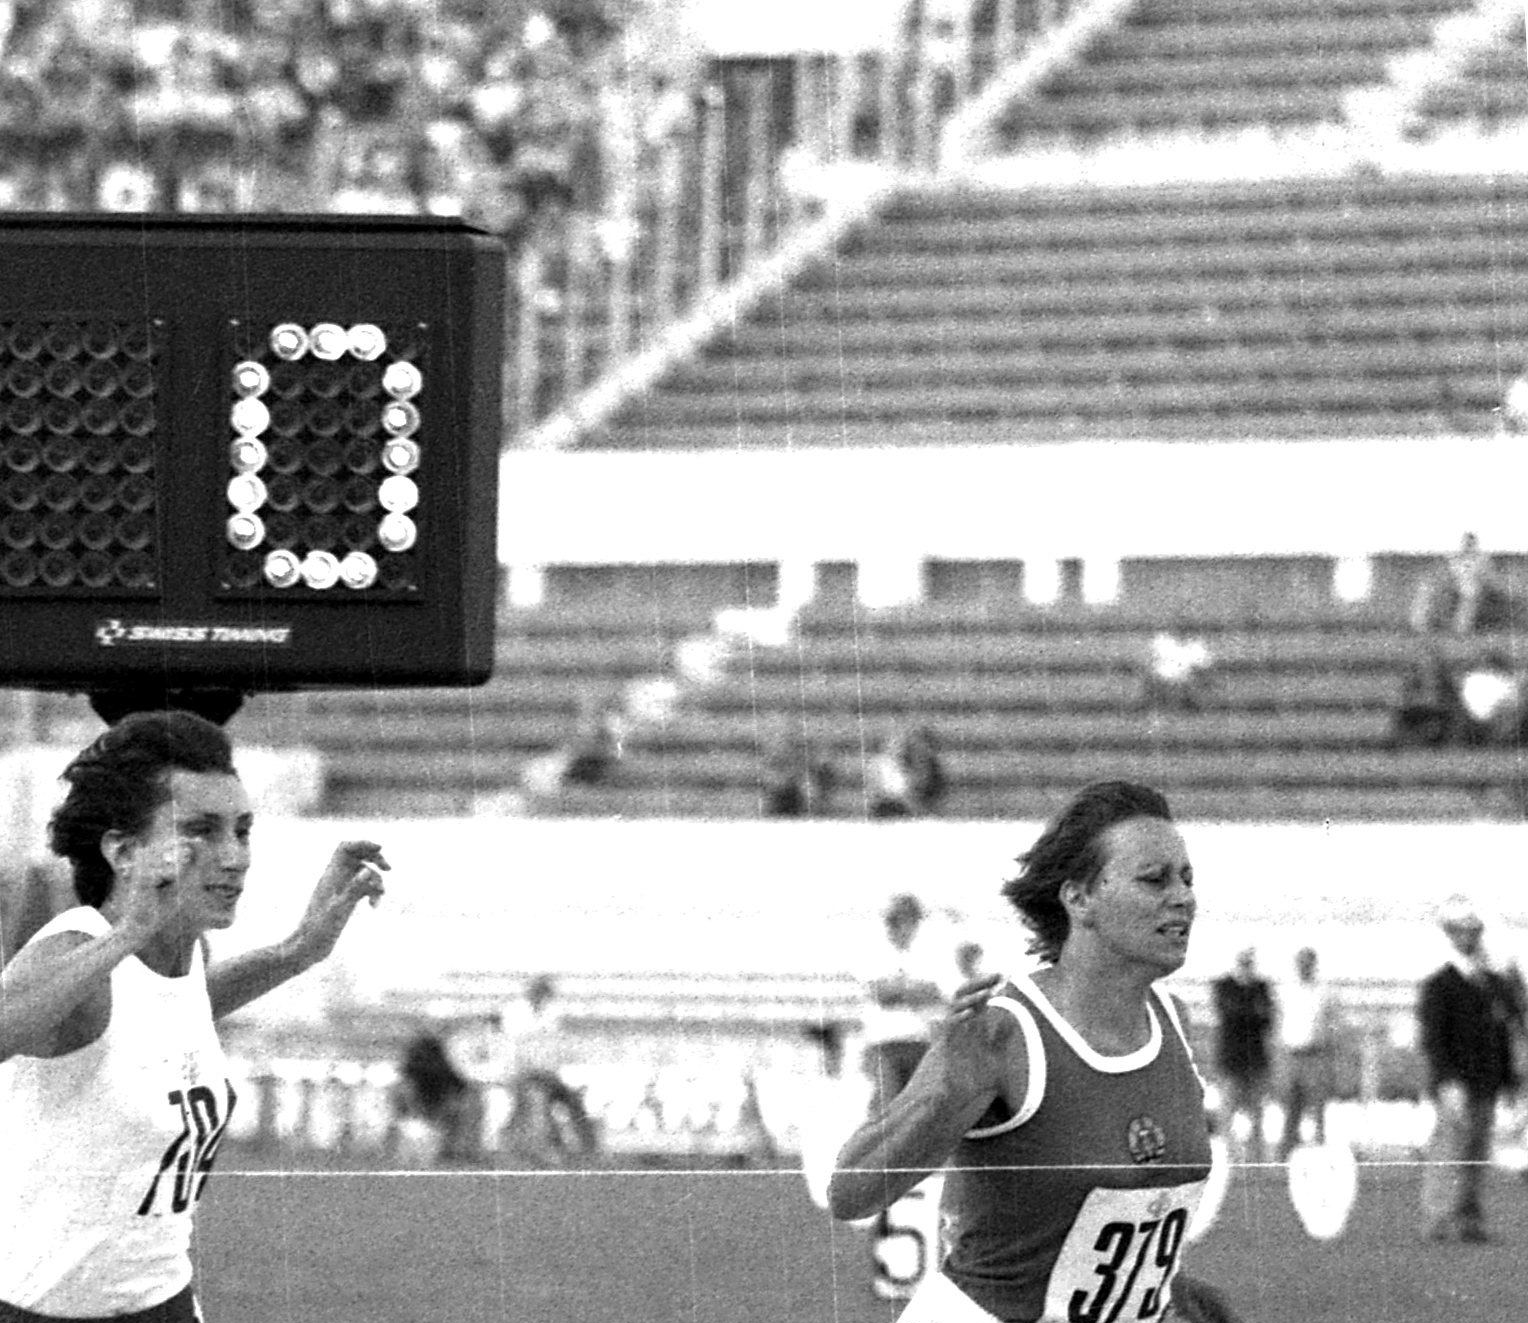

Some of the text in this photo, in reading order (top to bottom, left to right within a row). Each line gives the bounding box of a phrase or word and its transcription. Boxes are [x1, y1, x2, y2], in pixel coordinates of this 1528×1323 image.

[226, 322, 422, 589] 0
[127, 626, 292, 644] SWISS TIMING
